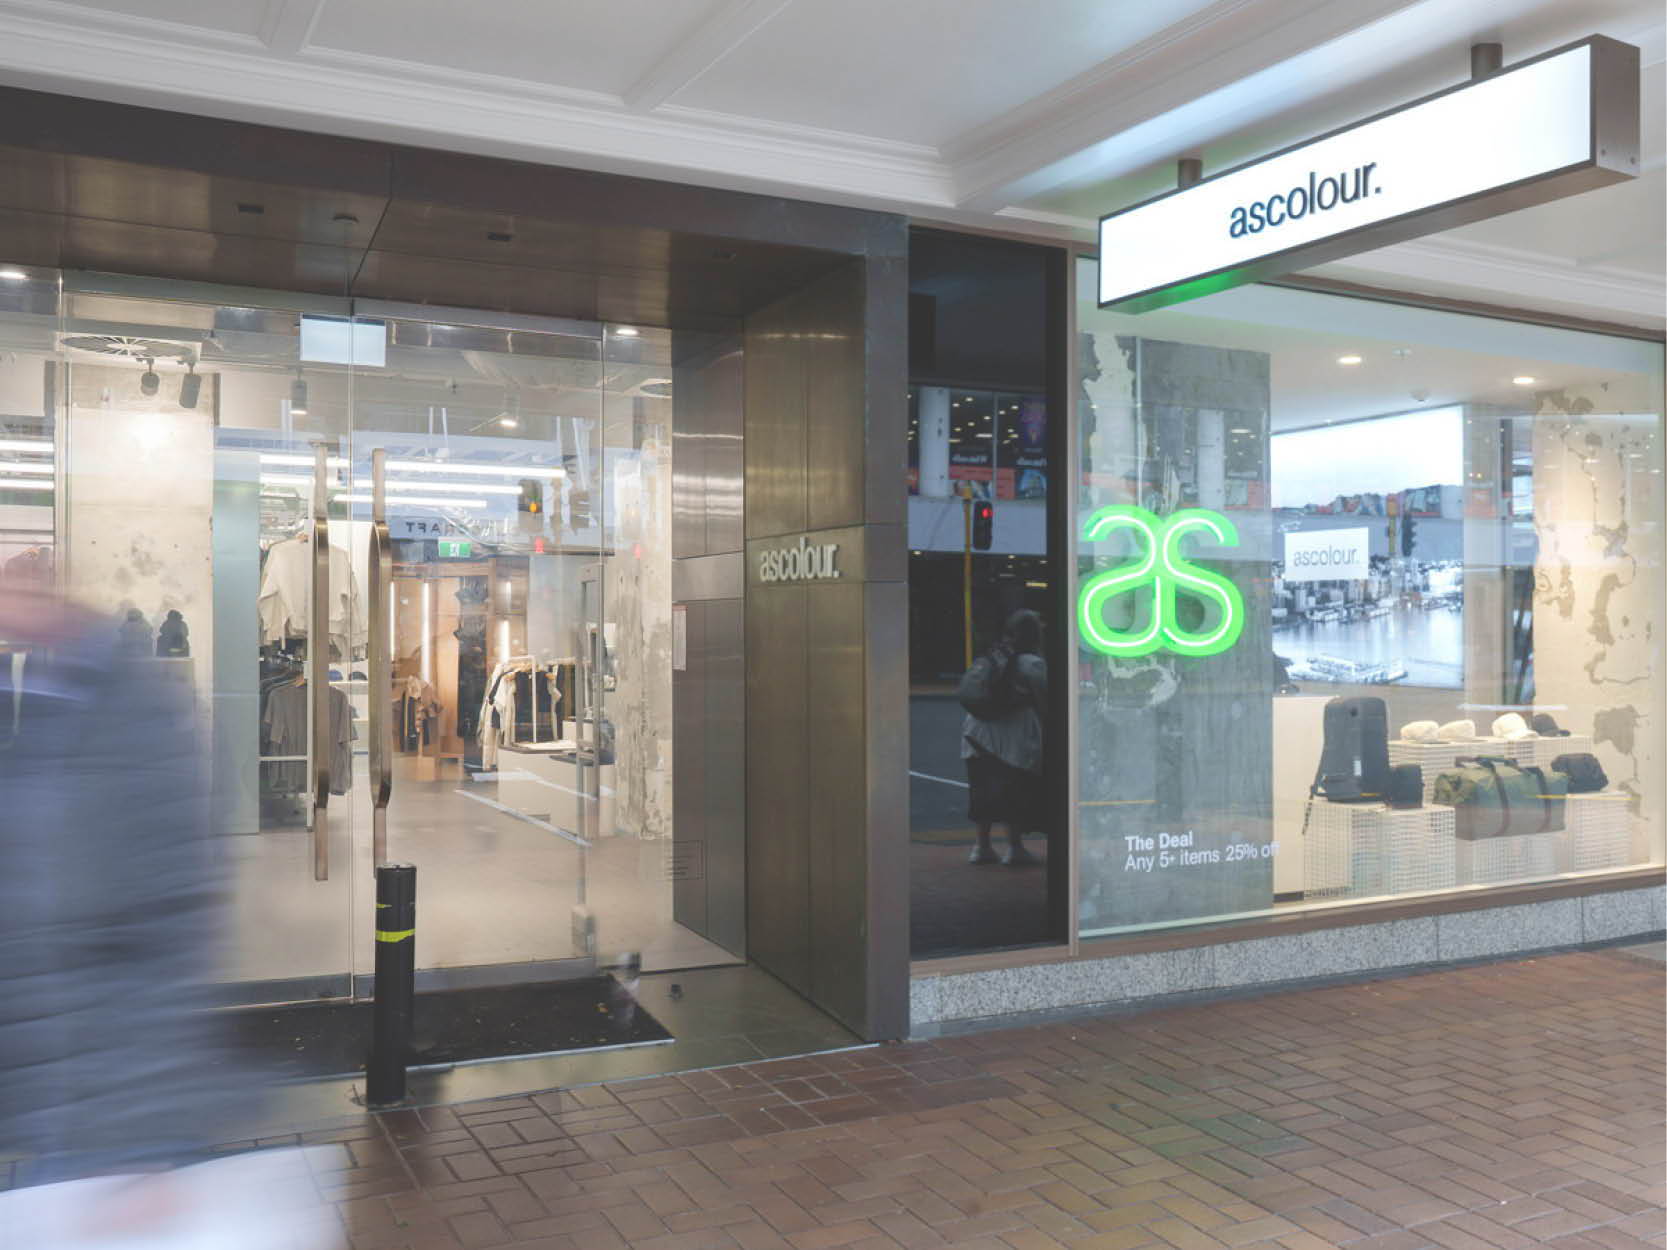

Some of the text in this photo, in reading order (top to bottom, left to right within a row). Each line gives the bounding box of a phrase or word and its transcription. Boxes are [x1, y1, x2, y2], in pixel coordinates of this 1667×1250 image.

[1229, 161, 1382, 239] ascolour.
[760, 536, 840, 582] ascolour.
[1124, 830, 1193, 852] The Deal
[1124, 853, 1154, 873] Any
[1159, 850, 1175, 868] 5+
[1180, 849, 1220, 866] items
[1225, 843, 1258, 862] 25%
